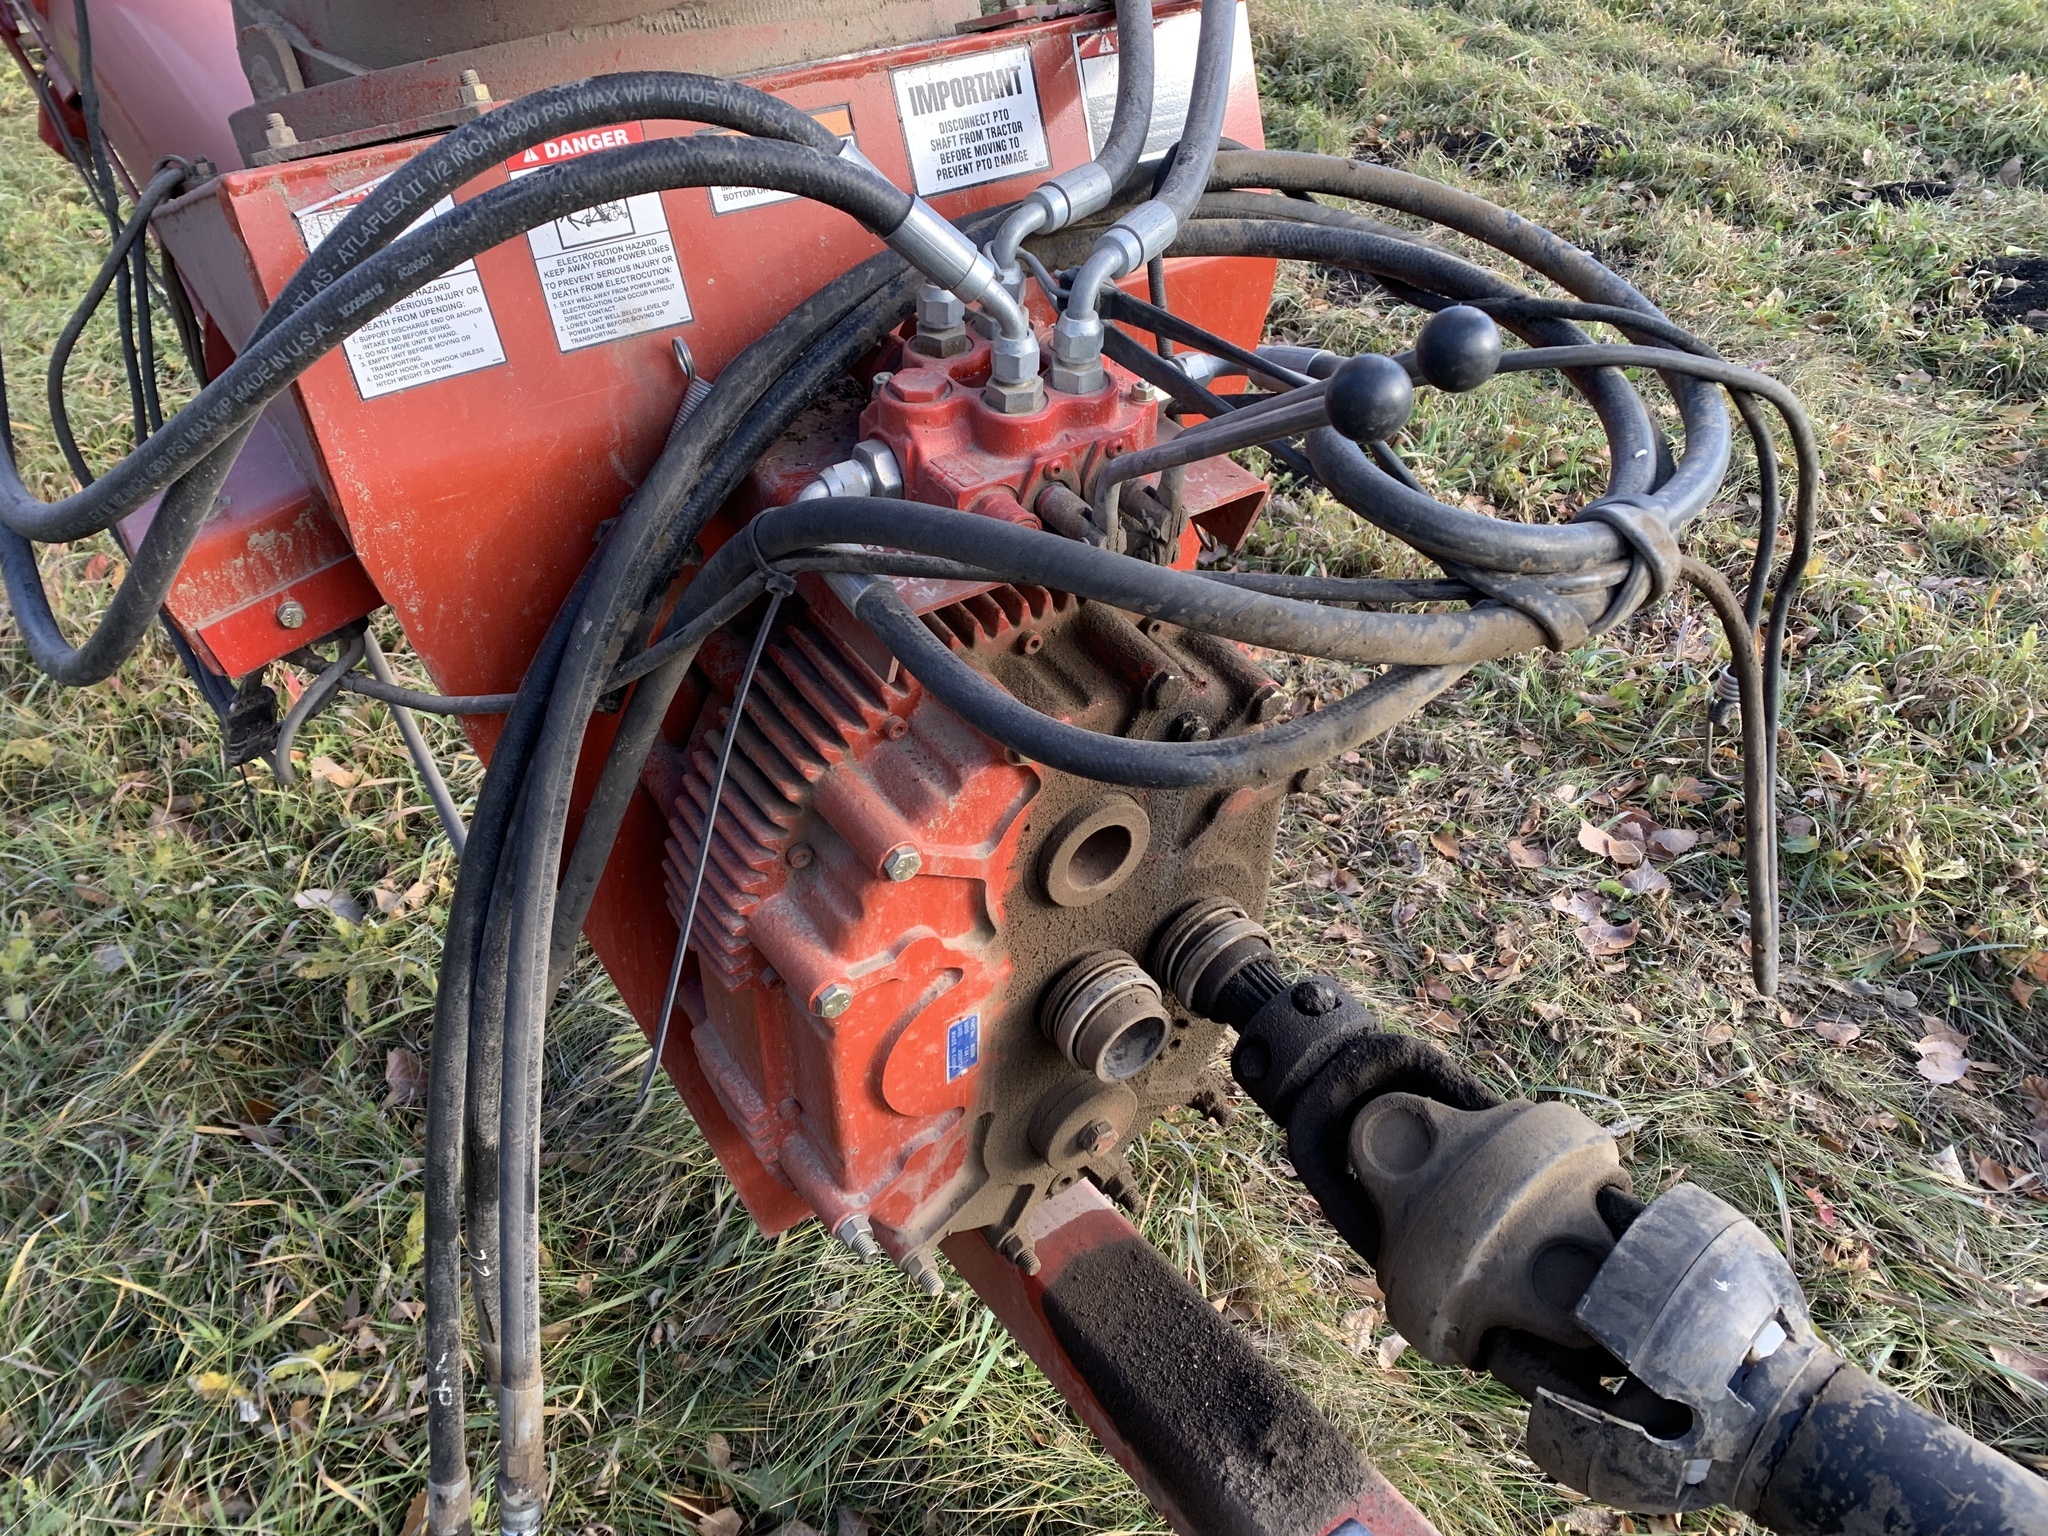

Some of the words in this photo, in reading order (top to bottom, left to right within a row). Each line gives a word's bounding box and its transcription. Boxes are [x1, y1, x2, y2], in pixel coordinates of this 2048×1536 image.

[908, 66, 1022, 116] IMPORTANT
[939, 112, 990, 134] DISCONNECT
[993, 108, 1009, 122] PTO
[544, 128, 630, 159] DANGER
[930, 135, 957, 152] SHAFT
[959, 130, 984, 145] FROM
[986, 121, 1024, 140] TRACTOR
[940, 147, 972, 165] BEFORE
[974, 139, 1007, 158] MOVING
[1008, 136, 1019, 148] TO
[337, 191, 412, 265] ATLAFLEX
[425, 159, 454, 185] 1/2
[450, 132, 497, 168] INCH
[499, 112, 540, 141] 4300
[541, 103, 574, 130] PSI
[576, 86, 623, 113] MAX
[622, 86, 657, 105] WP
[660, 84, 719, 108] MADE
[721, 93, 742, 114] IN
[936, 162, 974, 181] PREVENT
[976, 158, 992, 172] PTO
[995, 150, 1028, 167] DAMAGE
[723, 189, 755, 201] BOTTOM
[544, 268, 565, 279] KEEP
[567, 262, 591, 274] AWAY
[593, 257, 616, 268] FROM
[618, 250, 646, 263] POWER
[648, 244, 670, 255] LINES
[557, 246, 623, 266] ELECTROCUTION
[625, 238, 657, 252] HAZARD
[545, 281, 556, 291] TO
[558, 273, 594, 288] PREVENT
[596, 265, 631, 279] SERIOUS
[633, 258, 660, 270] INJURY
[661, 255, 673, 263] OR
[551, 288, 579, 300] DEATH
[581, 282, 605, 294] FROM
[606, 267, 673, 287] ELECTROCUTION:
[395, 297, 433, 313] SERIOUS
[435, 290, 464, 304] INJURY
[467, 285, 479, 295] OR
[416, 282, 451, 297] HAZARD
[560, 299, 575, 308] STAY
[576, 295, 593, 304] WELL
[594, 291, 611, 299] AWAY
[612, 287, 630, 296] FROM
[630, 281, 652, 292] POWER
[653, 277, 671, 286] LINES.
[562, 298, 613, 315] ELECTROCUTION
[614, 294, 627, 303] CAN
[627, 288, 649, 300] OCCUR
[649, 284, 675, 295] WITHOUT
[359, 330, 390, 343] SUPPORT
[391, 322, 430, 335] DISCHARGE
[431, 317, 445, 326] END
[445, 313, 456, 321] OR
[457, 307, 483, 319] ANCHOR
[361, 319, 390, 333] DEATH
[392, 313, 417, 325] FROM
[419, 301, 466, 319] UPENDING:
[564, 312, 586, 322] DIRECT
[588, 306, 617, 318] CONTACT.
[566, 319, 589, 330] LOWER
[590, 316, 603, 325] UNIT
[604, 312, 621, 322] WELL
[622, 307, 642, 316] BELOW
[643, 303, 661, 312] LEVEL
[569, 327, 591, 337] POWER
[592, 324, 606, 332] LINE
[607, 318, 630, 329] BEFORE
[631, 313, 655, 323] MOVING
[363, 340, 386, 350] INTAKE
[387, 336, 401, 345] END
[402, 329, 429, 342] BEFORE
[430, 324, 452, 334] USING.
[365, 350, 375, 358] DO
[376, 347, 390, 355] NOT
[392, 342, 411, 352] MOVE
[412, 338, 426, 347] UNIT
[428, 335, 437, 343] BY
[438, 330, 458, 340] HAND.
[571, 329, 619, 344] TRANSPORTING.
[368, 355, 390, 366] EMPTY
[391, 351, 405, 360] UNIT
[408, 344, 434, 357] BEFORE
[436, 338, 460, 351] MOVING
[371, 356, 423, 373] TRANSPORTING.
[373, 373, 383, 381] DO
[384, 369, 399, 378] NOT
[400, 364, 419, 374] HOOK
[431, 352, 459, 367] UNHOOK
[461, 347, 485, 359] UNLESS
[376, 378, 397, 388] HITCH
[398, 371, 422, 383] WEIGHT
[431, 364, 454, 374] DOWN.
[168, 439, 190, 460] PSI
[187, 415, 216, 443] MAX
[232, 361, 275, 404] MADE
[269, 347, 291, 371] IN
